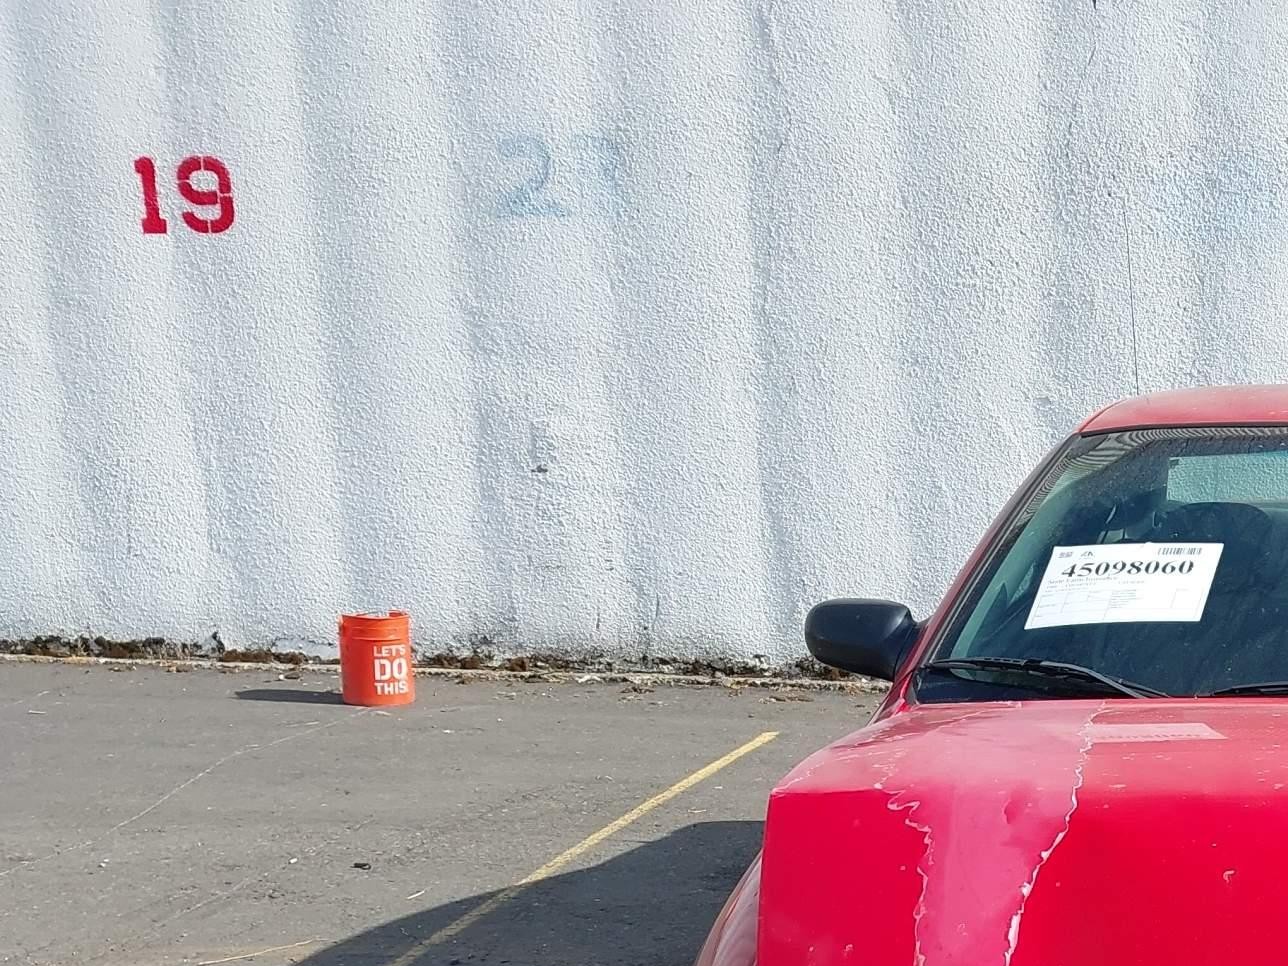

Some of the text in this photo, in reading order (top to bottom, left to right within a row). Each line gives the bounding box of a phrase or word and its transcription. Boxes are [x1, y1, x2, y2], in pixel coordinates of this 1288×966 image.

[134, 156, 234, 234] 19
[1061, 560, 1195, 577] 45098060
[374, 658, 408, 681] DO
